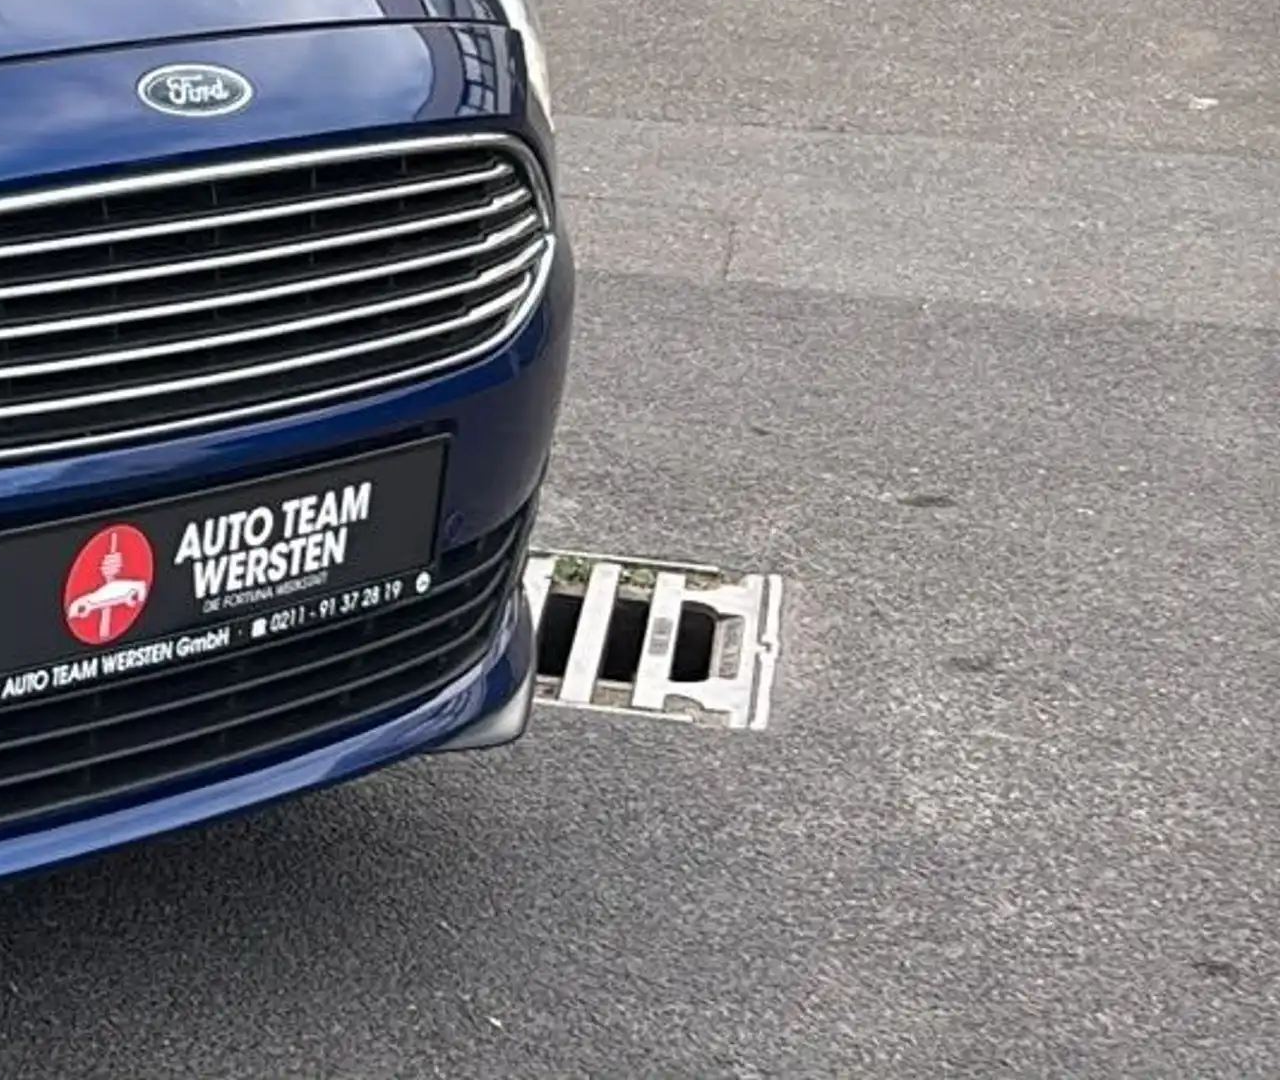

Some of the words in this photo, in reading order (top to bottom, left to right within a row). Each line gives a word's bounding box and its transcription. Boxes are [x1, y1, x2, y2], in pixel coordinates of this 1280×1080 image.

[166, 75, 230, 104] Ford
[174, 506, 274, 565] AUTO
[281, 481, 372, 539] TEAM
[193, 526, 348, 600] WERSTEN
[0, 670, 49, 700] AUTO
[51, 660, 98, 687] TEAM
[101, 640, 173, 674] WERSTEN
[175, 626, 231, 657] GmbH
[270, 604, 306, 633] 0211
[319, 597, 336, 619] 91
[339, 591, 359, 614] 37
[360, 584, 381, 608] 28
[384, 580, 404, 602] 19
